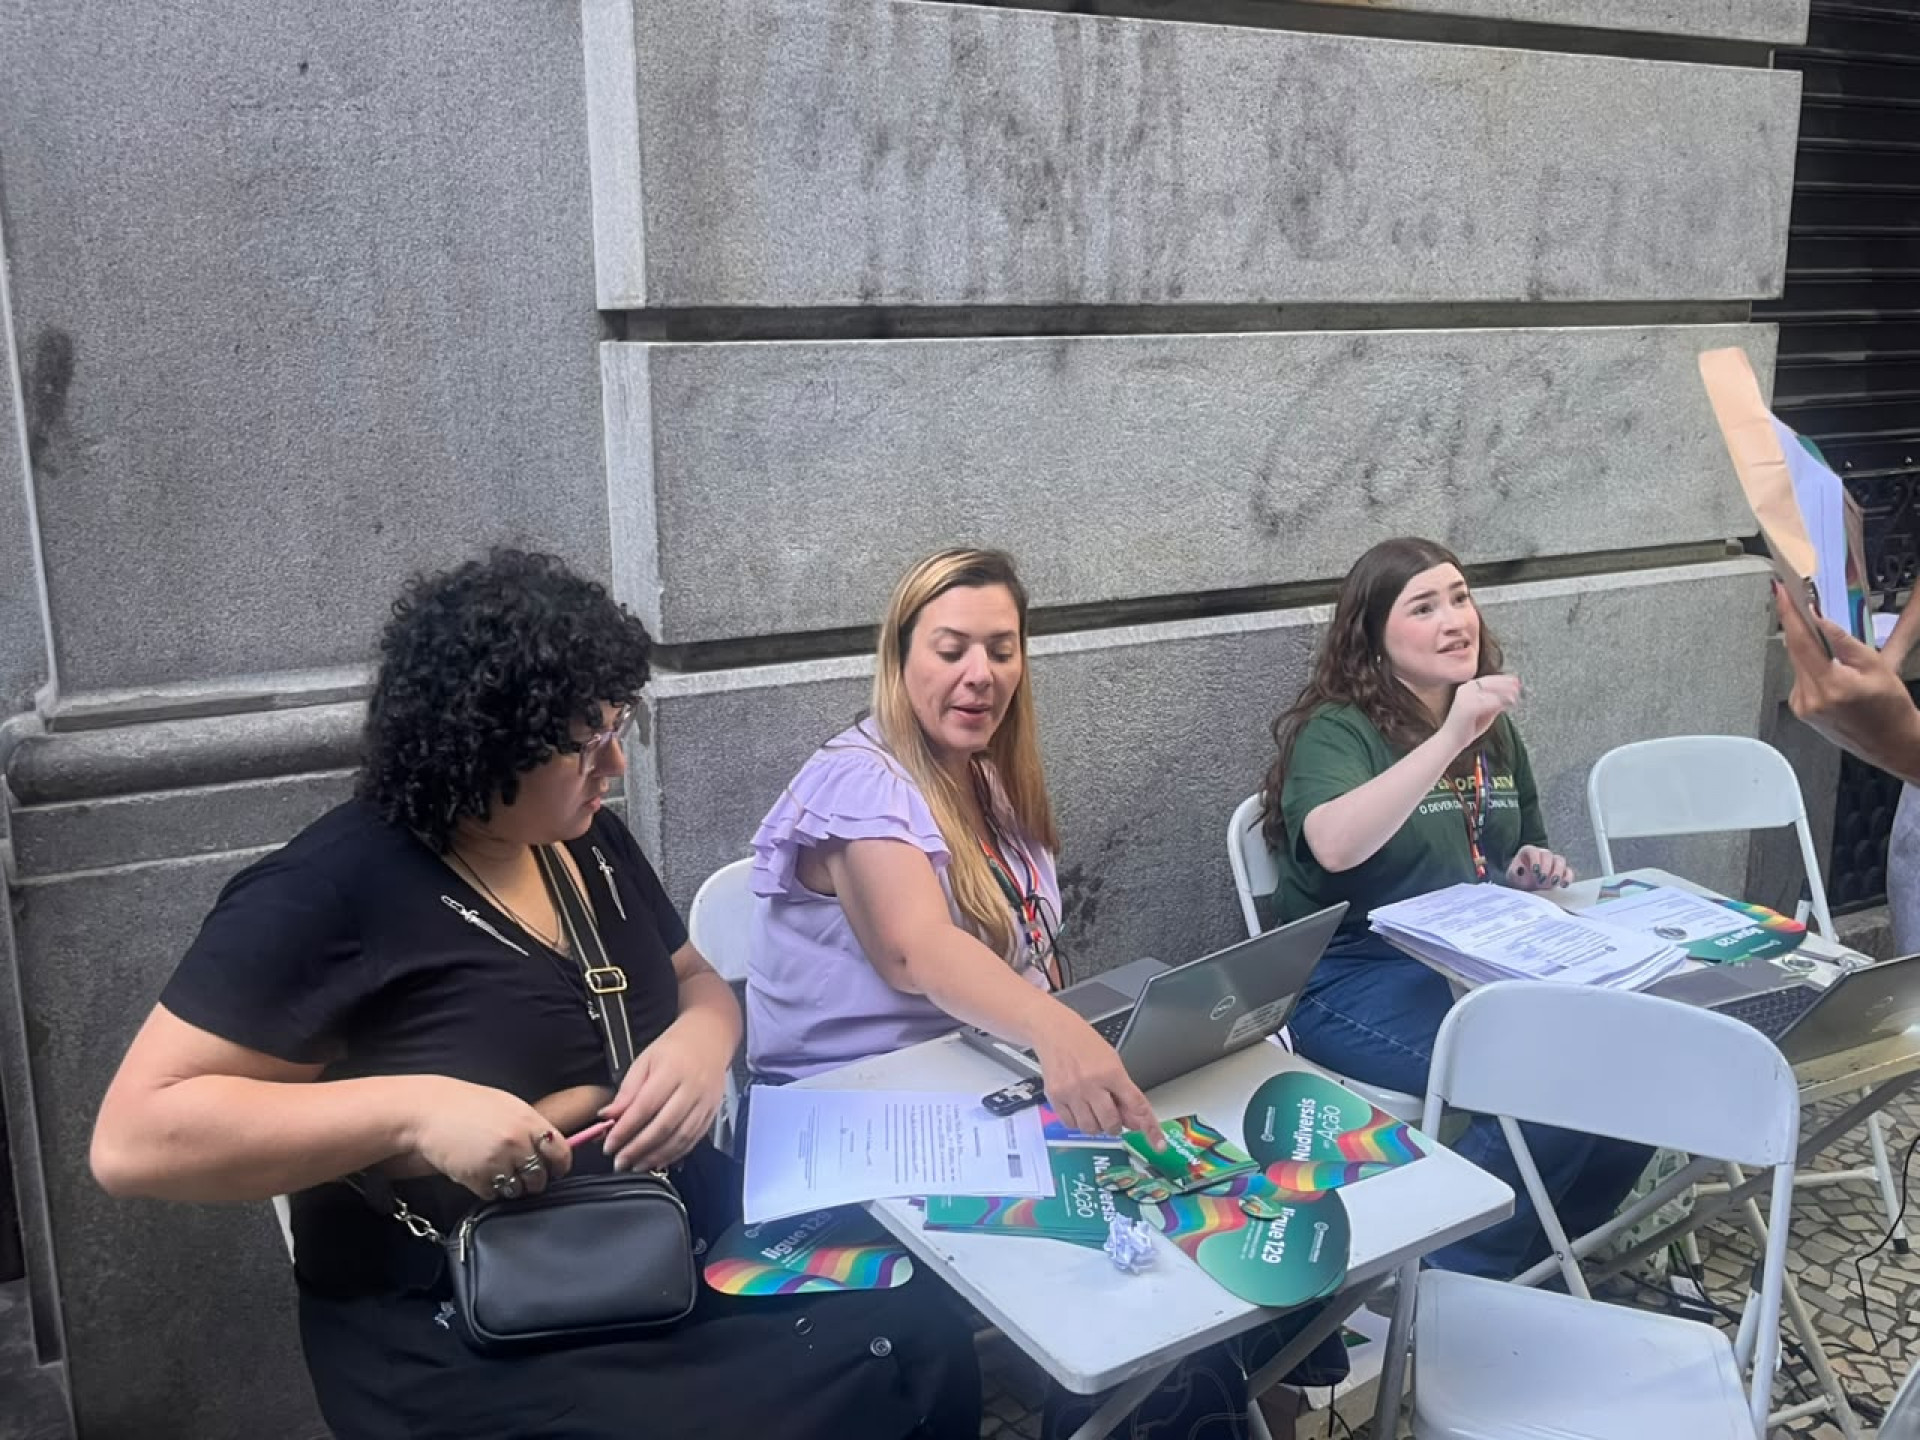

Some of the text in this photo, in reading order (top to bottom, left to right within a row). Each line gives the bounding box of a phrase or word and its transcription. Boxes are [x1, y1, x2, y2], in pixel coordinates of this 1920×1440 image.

[1291, 1098, 1316, 1161] Nudiversis
[1317, 1105, 1342, 1143] Ação
[1070, 1179, 1095, 1218] Ação
[1092, 1155, 1116, 1222] Nuversis
[1261, 1241, 1285, 1264] 129
